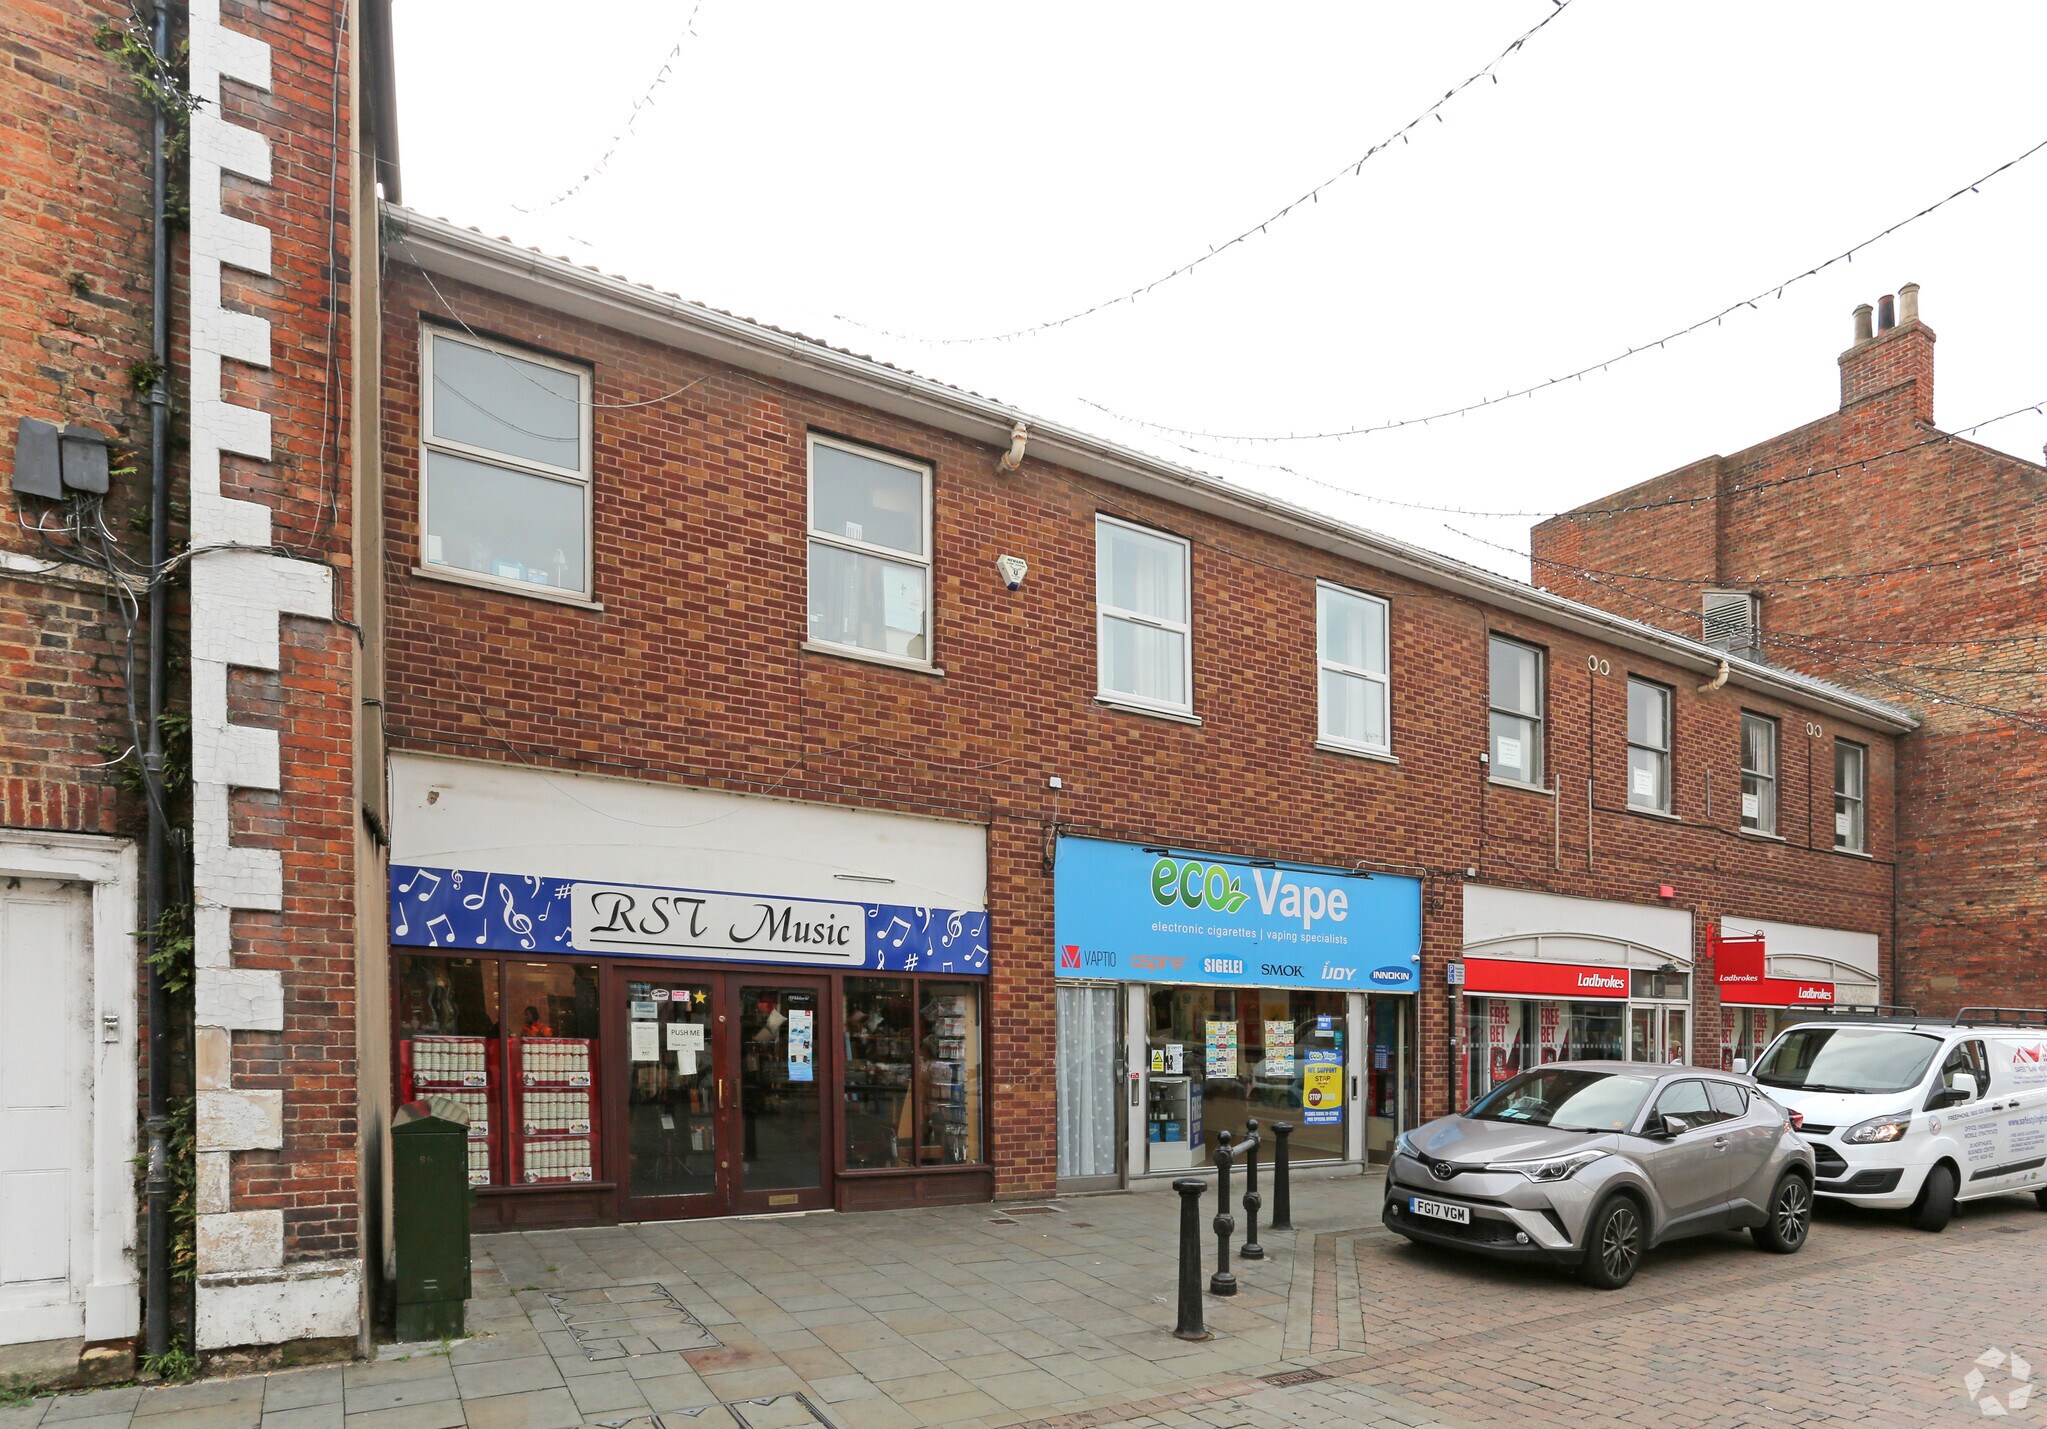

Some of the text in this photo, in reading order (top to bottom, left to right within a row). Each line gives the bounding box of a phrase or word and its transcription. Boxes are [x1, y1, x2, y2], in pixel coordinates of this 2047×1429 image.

[1151, 858, 1348, 930] eco Vape
[590, 891, 850, 945] RST Music
[1152, 921, 1348, 945] electronic cigarettes vaping specialists
[1084, 950, 1117, 968] VAPTIO
[1130, 953, 1184, 973] aspire
[1204, 957, 1243, 975] SIGELEI
[1261, 963, 1304, 978] SMOK
[1373, 971, 1410, 981] INNOKIN
[1719, 974, 1758, 982] Ladbrokes
[1577, 972, 1625, 989] Ladbrokes
[1798, 986, 1832, 1000] Ladbrokes
[1490, 1006, 1509, 1024] FREE
[1541, 1008, 1559, 1025] FREE
[1722, 1013, 1735, 1028] FREE
[1754, 1013, 1767, 1029] FREE
[689, 1029, 701, 1037] ME
[1490, 1025, 1505, 1043] BET
[1541, 1026, 1556, 1043] BET
[1722, 1029, 1732, 1043] BET
[1754, 1029, 1764, 1043] BET
[1309, 1093, 1321, 1101] STOP
[1417, 1201, 1465, 1221] FG17 VGM
